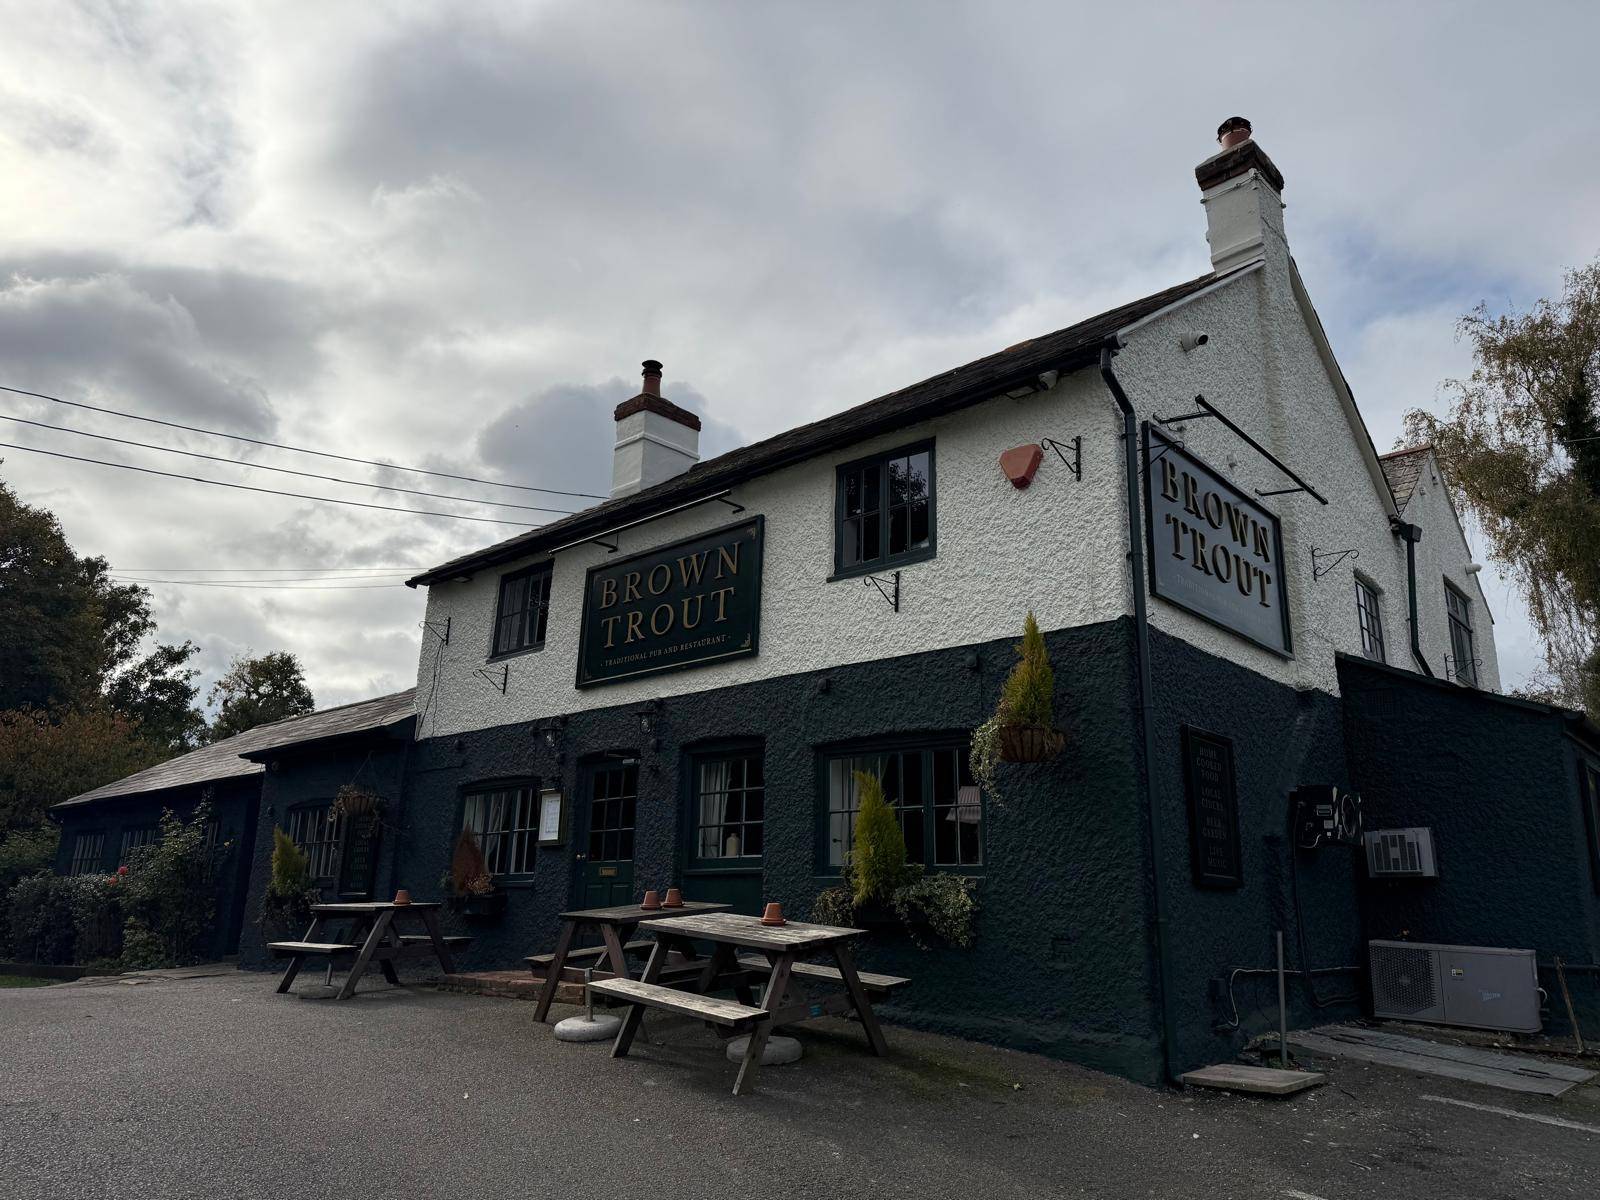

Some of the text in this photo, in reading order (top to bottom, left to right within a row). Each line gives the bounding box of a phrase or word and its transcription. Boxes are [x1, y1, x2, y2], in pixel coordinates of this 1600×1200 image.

[1160, 456, 1270, 562] BROWN
[599, 541, 742, 609] BROWN
[1165, 513, 1272, 607] TROUT
[601, 587, 735, 648] TROUT
[604, 634, 727, 667] TRADITIONAL PUB AND RESTAURANT
